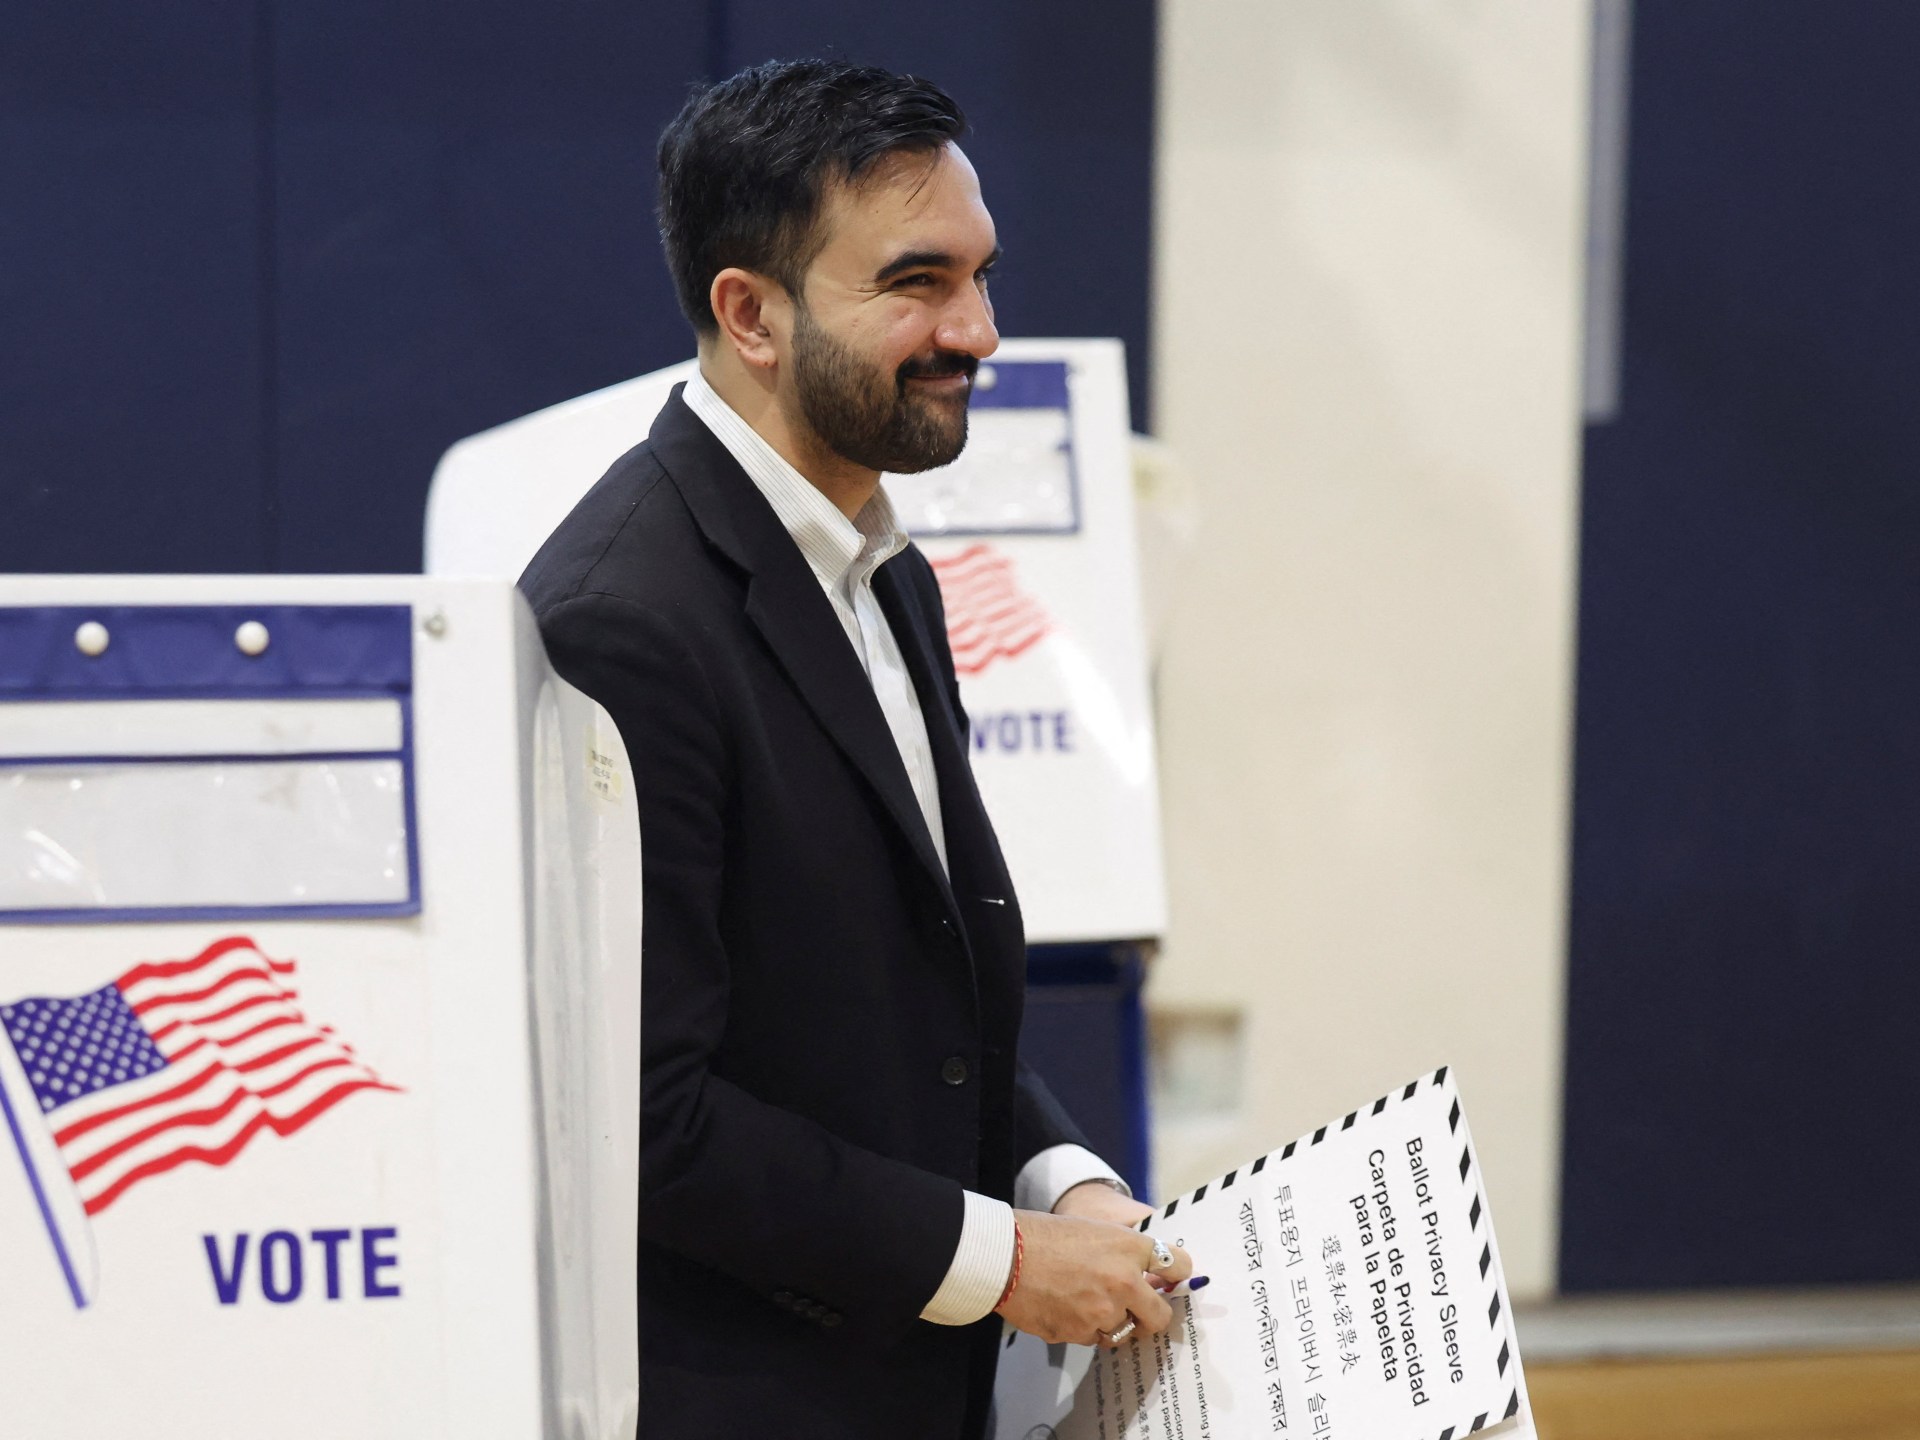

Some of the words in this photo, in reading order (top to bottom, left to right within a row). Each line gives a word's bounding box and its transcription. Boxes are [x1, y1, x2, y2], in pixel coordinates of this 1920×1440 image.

[968, 711, 1074, 752] VOTE
[1349, 1194, 1374, 1247] para
[1368, 1148, 1398, 1242] Carpeta
[1238, 1197, 1265, 1273] ব্যালটের
[1364, 1250, 1381, 1275] la
[1387, 1247, 1405, 1278] de
[1405, 1136, 1433, 1208] Ballot
[1421, 1210, 1449, 1298] Privacy
[1439, 1303, 1464, 1384] Sleeve
[202, 1227, 402, 1305] VOTE
[1273, 1184, 1304, 1268] 투표용지
[1290, 1276, 1323, 1384] 프라이버시
[1183, 1294, 1200, 1362] nstructions
[1250, 1278, 1279, 1374] গোপনীয়তা
[1369, 1278, 1398, 1382] Papeleta
[1393, 1281, 1430, 1408] Privacidad
[1154, 1345, 1166, 1386] marcar
[1166, 1352, 1175, 1372] las
[1193, 1363, 1202, 1380] on
[1160, 1388, 1169, 1404] su
[1161, 1406, 1175, 1440] papel
[1169, 1372, 1185, 1440] instruccion
[1196, 1382, 1210, 1431] marking
[1267, 1377, 1288, 1433] রক্ষার
